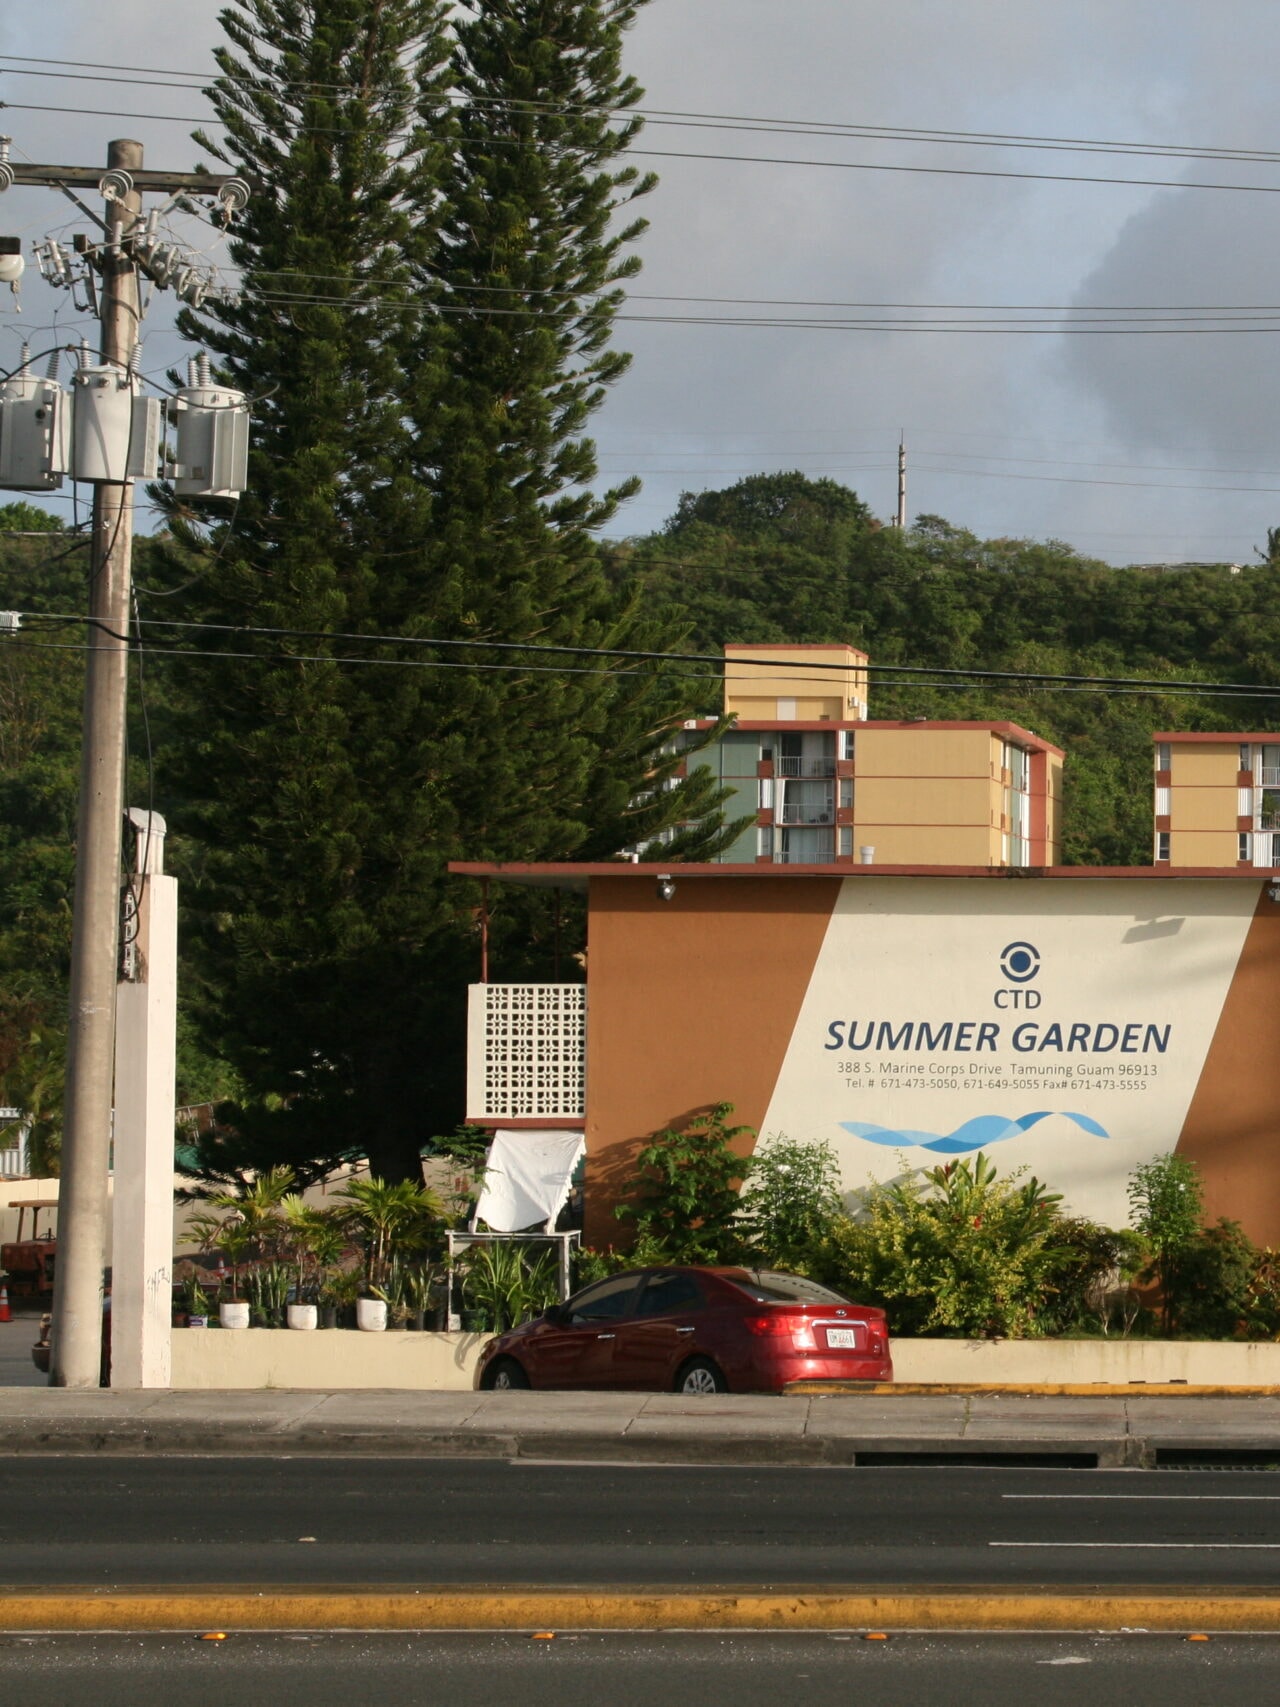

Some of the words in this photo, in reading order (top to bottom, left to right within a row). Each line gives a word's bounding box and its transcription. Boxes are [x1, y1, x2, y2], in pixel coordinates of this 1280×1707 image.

[993, 988, 1042, 1010] CTD
[824, 1020, 1001, 1052] SUMMER
[1011, 1022, 1172, 1054] GARDEN
[837, 1062, 861, 1074] 388
[864, 1062, 876, 1074] S.
[879, 1062, 925, 1075] Marine
[928, 1062, 966, 1077] Corps
[969, 1063, 1003, 1075] Drive
[1009, 1063, 1074, 1078] Tamuning
[1076, 1064, 1115, 1076] Guam
[1118, 1064, 1158, 1077] 96913
[845, 1078, 865, 1089] Tel.
[867, 1078, 875, 1089] #
[880, 1078, 961, 1091] 671-473-5050,
[963, 1079, 1040, 1090] 671-649-5055
[1042, 1079, 1068, 1090] Fax#
[1070, 1079, 1147, 1091] 671-473-5555
